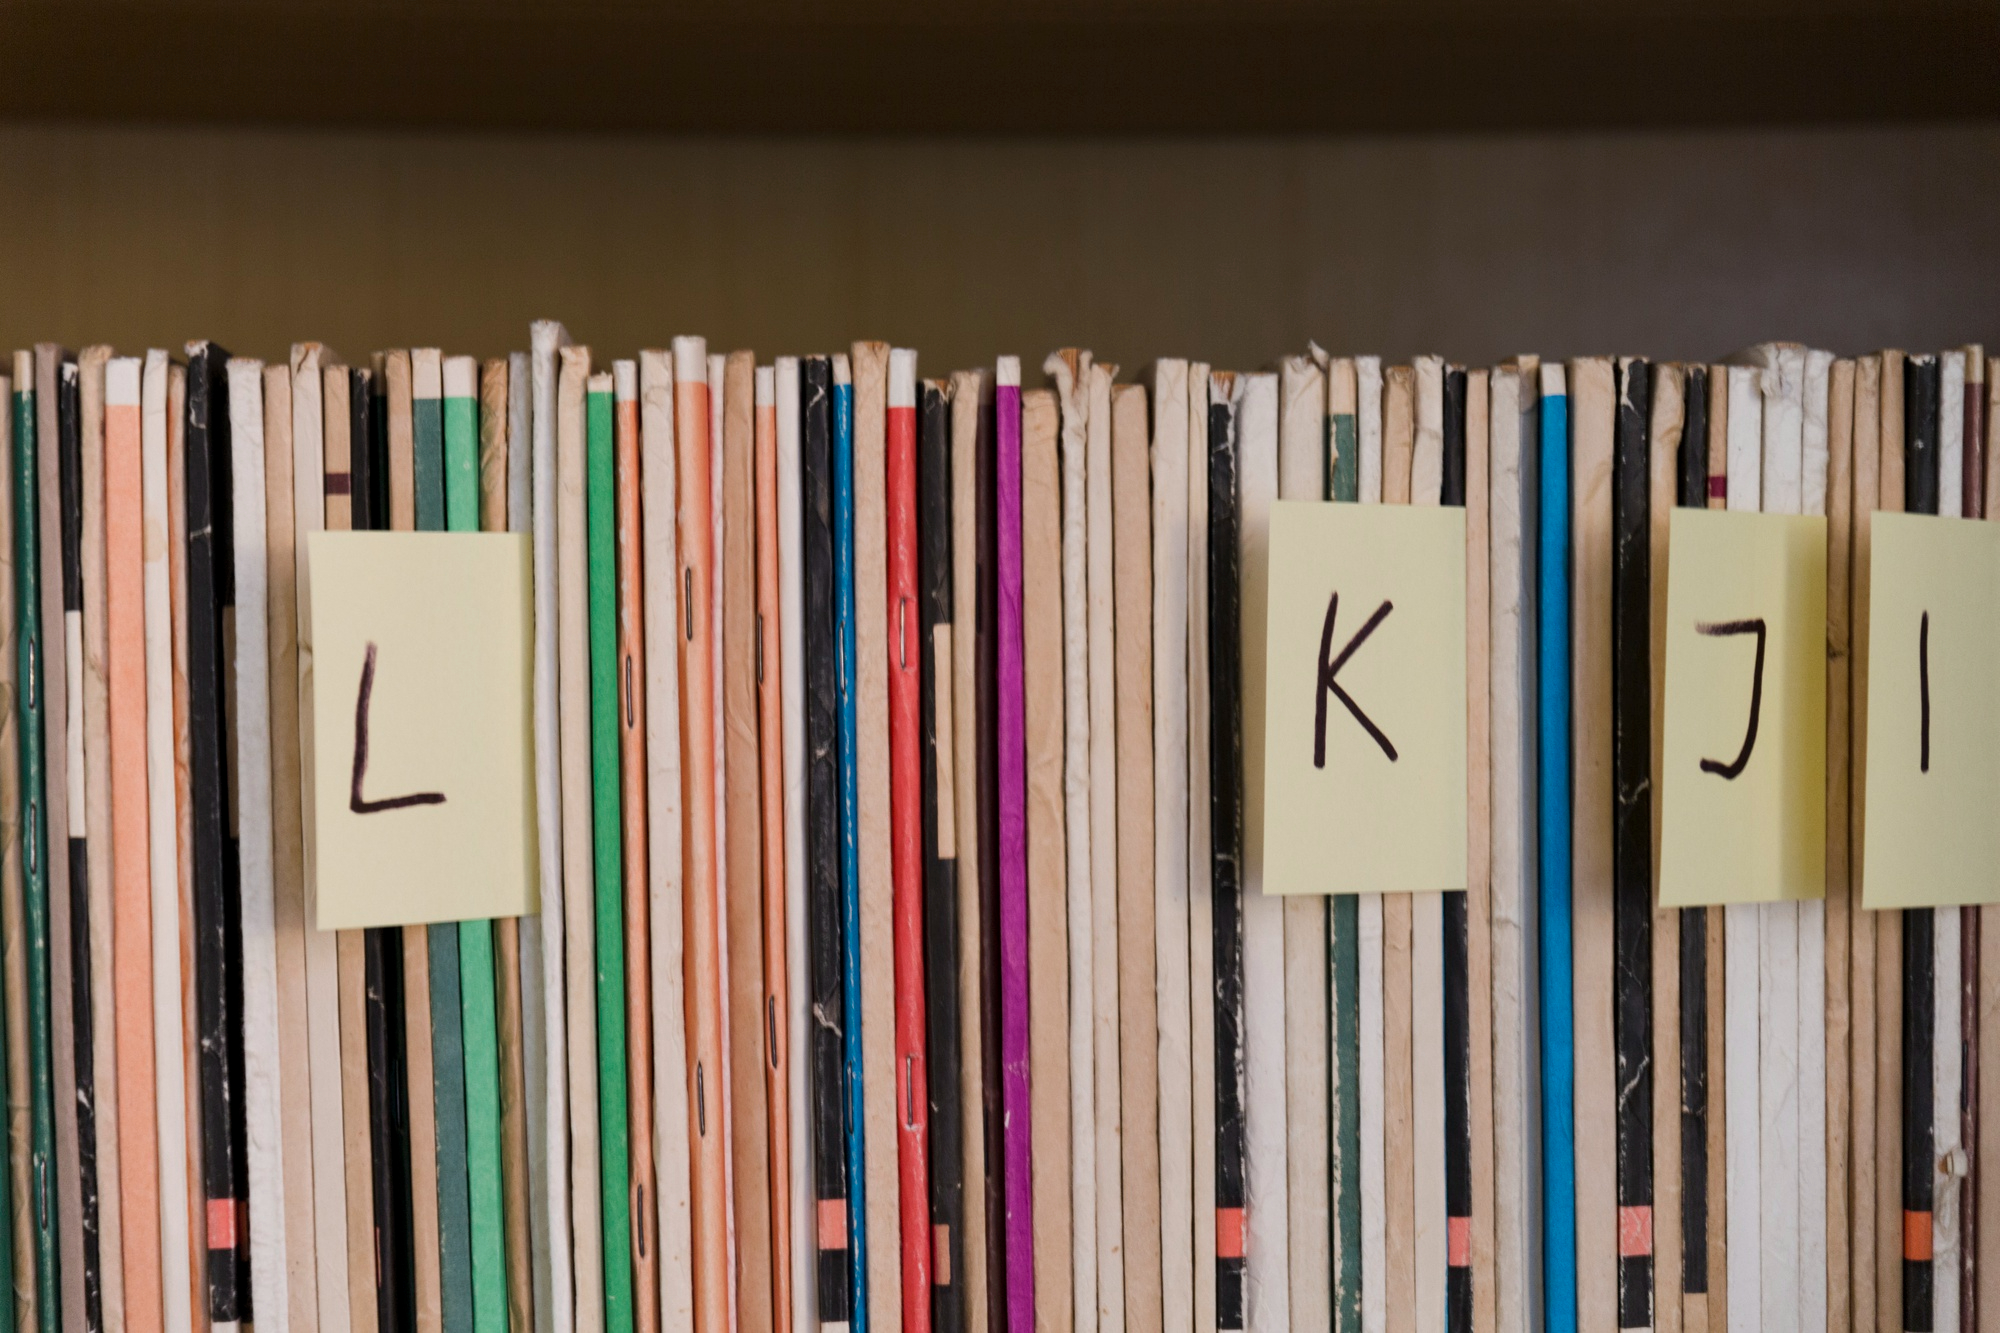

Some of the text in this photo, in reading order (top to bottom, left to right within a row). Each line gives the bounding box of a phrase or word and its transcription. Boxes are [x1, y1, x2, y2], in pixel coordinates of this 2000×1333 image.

[349, 641, 447, 815] L
[1313, 590, 1399, 770] K
[1695, 617, 1767, 781] J
[1918, 609, 1931, 775] I
